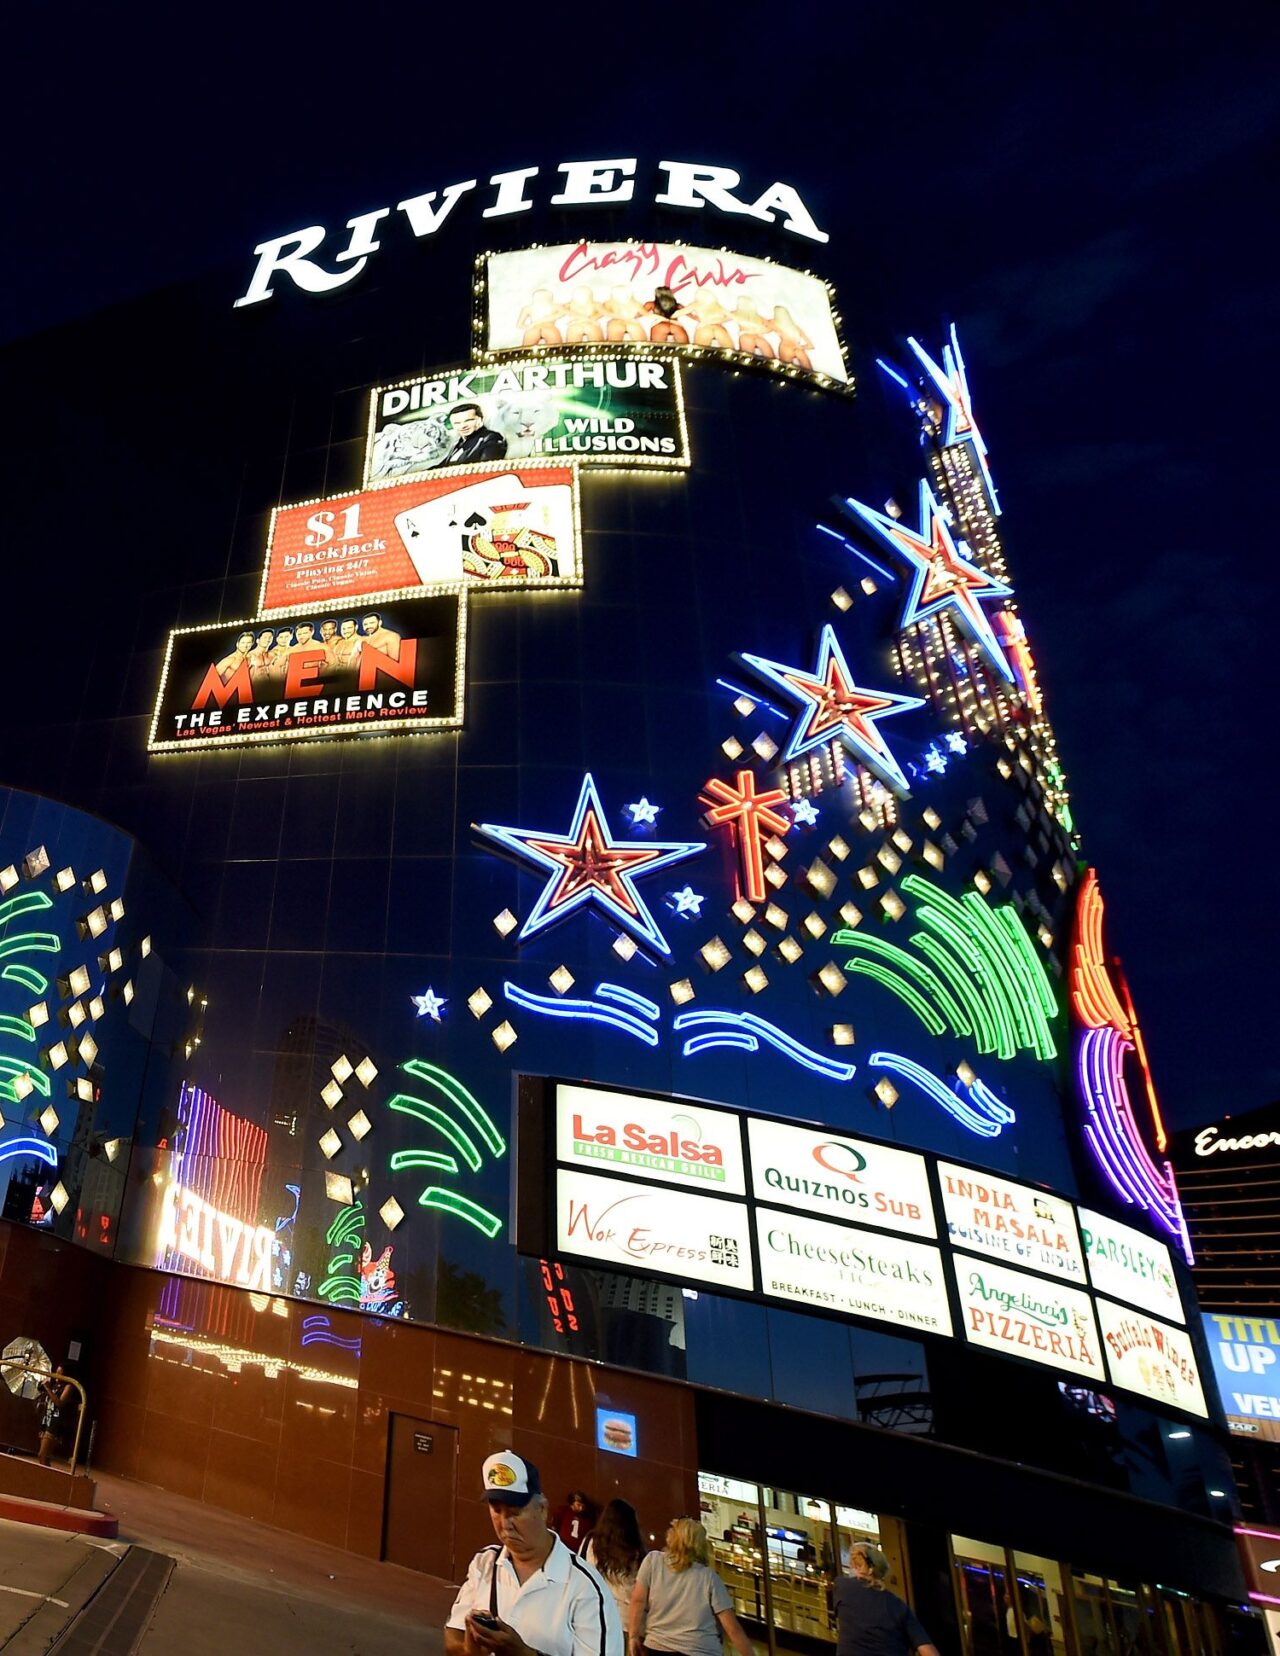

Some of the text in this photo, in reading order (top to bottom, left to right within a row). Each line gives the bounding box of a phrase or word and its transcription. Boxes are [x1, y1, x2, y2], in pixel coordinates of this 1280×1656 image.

[233, 158, 829, 307] RIVIERA
[559, 242, 659, 282] Crazy
[382, 362, 668, 417] DIRK ARTHUR
[535, 435, 676, 454] ILLUSIONS
[564, 417, 635, 434] WILD
[304, 503, 364, 548] $1
[284, 538, 387, 567] blackjack
[296, 559, 369, 579] Playing 24/7
[191, 638, 418, 710] MEN
[174, 690, 428, 729] THE EXPERIENCE
[176, 728, 196, 737] Las
[238, 719, 281, 731] Newest
[284, 717, 292, 726] &
[297, 712, 342, 725] Hottest
[345, 709, 376, 720] Male
[379, 705, 428, 717] Review
[573, 1114, 723, 1166] La Salsa
[577, 1142, 718, 1178] FRESH MEXICAN GRILL
[945, 1176, 1018, 1212] INDIA
[568, 1197, 707, 1261] Wok Express
[974, 1208, 1070, 1252] MASALA
[767, 1229, 933, 1287] CheeseSteaks
[1081, 1228, 1156, 1281] PARSLEY
[772, 1280, 938, 1327] BREAKFAST LUNCH DINNER
[968, 1307, 1095, 1366] PIZZERIA
[1218, 1341, 1277, 1375] UP
